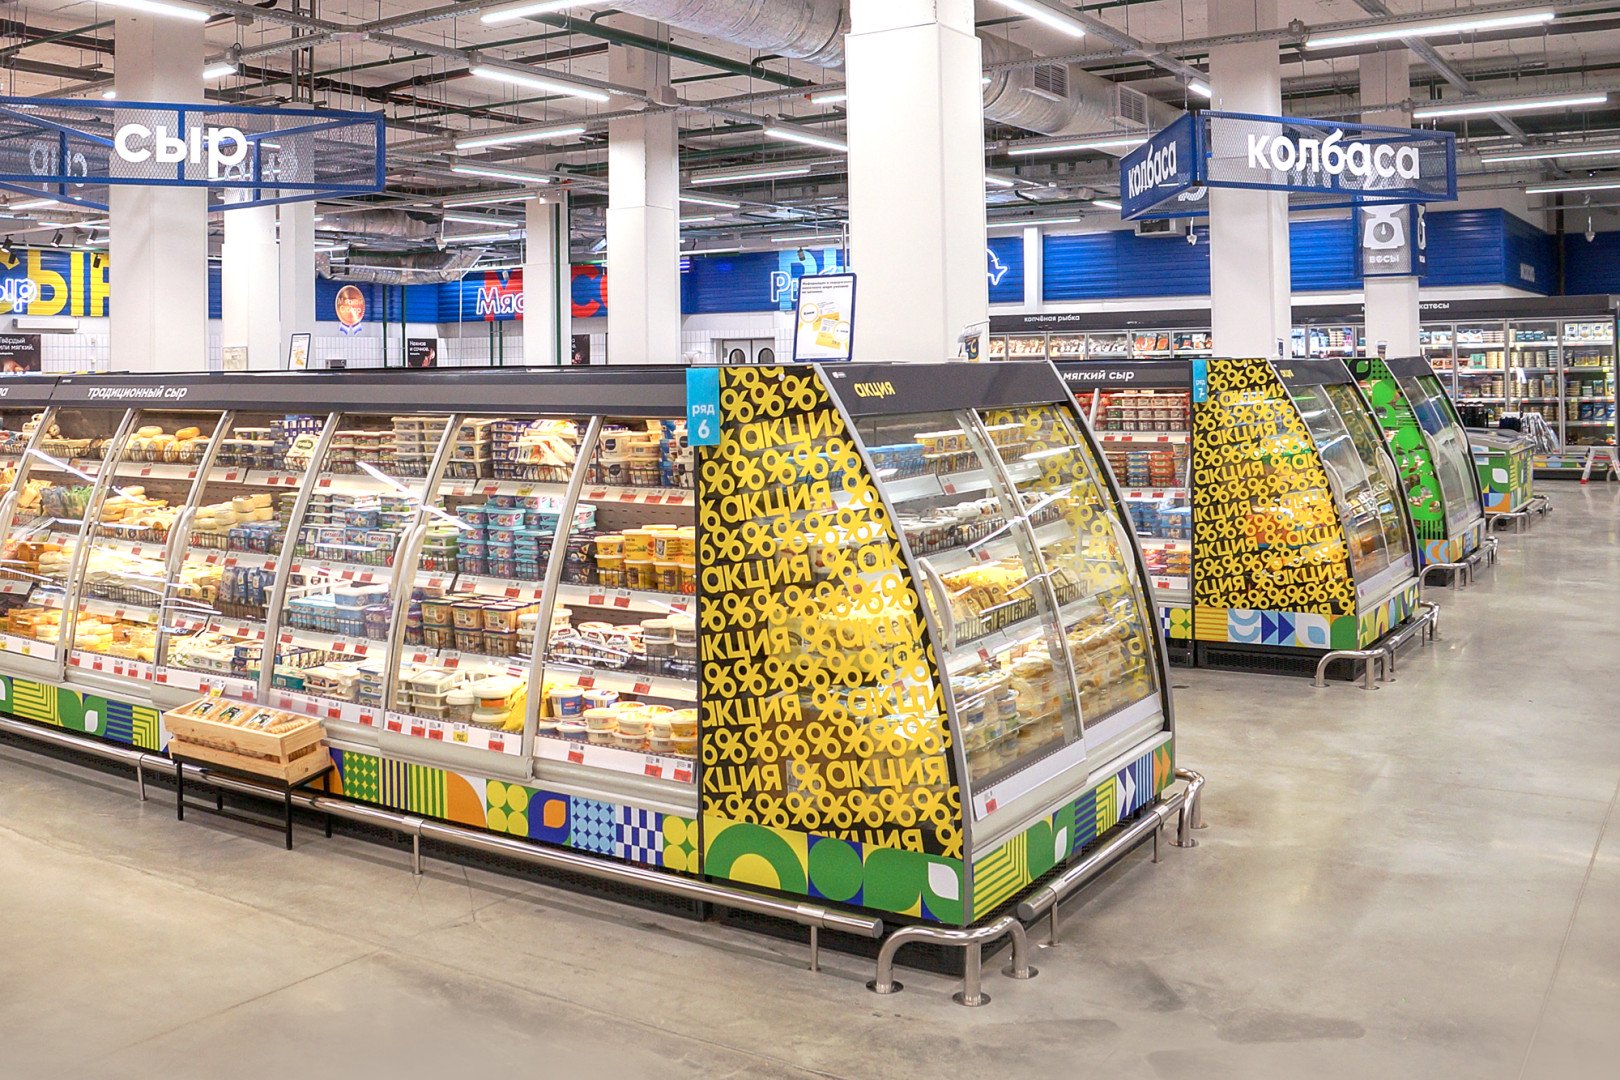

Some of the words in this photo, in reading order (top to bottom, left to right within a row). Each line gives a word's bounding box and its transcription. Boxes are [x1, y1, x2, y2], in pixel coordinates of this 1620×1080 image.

[114, 123, 248, 180] сыр
[1248, 128, 1420, 179] колбаса
[1128, 140, 1177, 199] колбаса
[1369, 254, 1399, 263] весы
[1024, 314, 1057, 324] копчёная
[1057, 314, 1080, 325] рыбка
[1063, 370, 1106, 380] мягкий
[1109, 371, 1135, 382] сыр
[88, 385, 164, 400] традиционный
[164, 386, 188, 400] сыр
[854, 381, 896, 399] акция
[692, 403, 715, 417] ряд
[698, 419, 710, 439] 6
[1207, 420, 1277, 447] акция
[1195, 460, 1264, 486] акция
[720, 480, 832, 523] акция
[1194, 499, 1250, 523] кция
[701, 554, 812, 593] акция
[1273, 562, 1348, 588] акция
[702, 626, 791, 664] кция
[826, 756, 948, 793] акция
